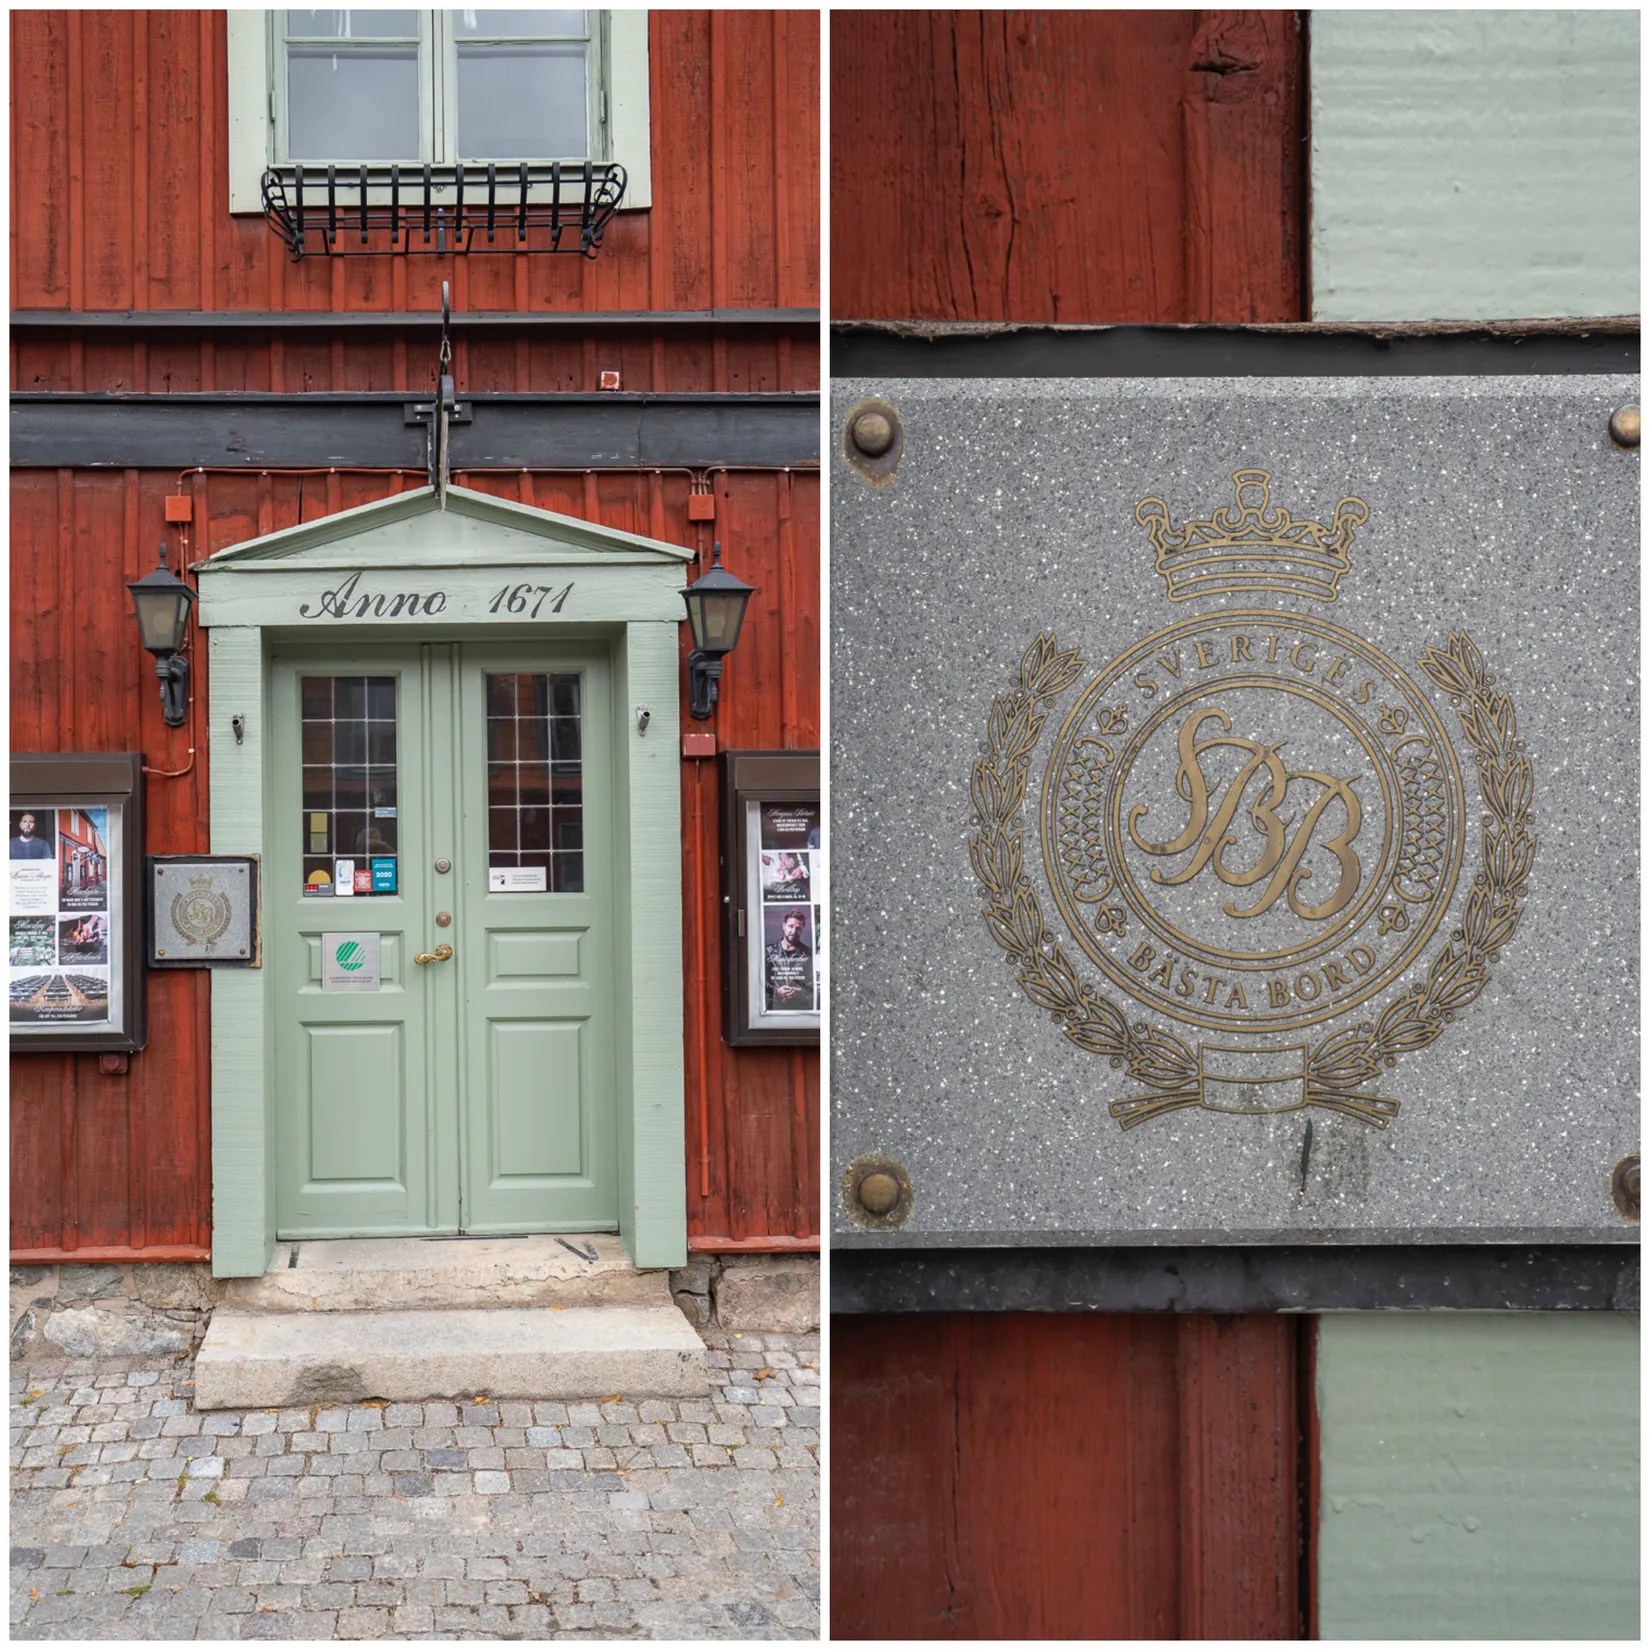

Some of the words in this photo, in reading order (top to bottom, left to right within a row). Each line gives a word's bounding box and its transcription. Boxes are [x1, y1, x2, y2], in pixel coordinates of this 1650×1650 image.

[299, 571, 447, 619] Anno
[489, 582, 575, 619] 1671
[1133, 634, 1377, 704] SVERIGES
[1129, 707, 1363, 921] SBB
[1127, 941, 1248, 1010] BÄSTA
[1268, 943, 1376, 1009] BORD
